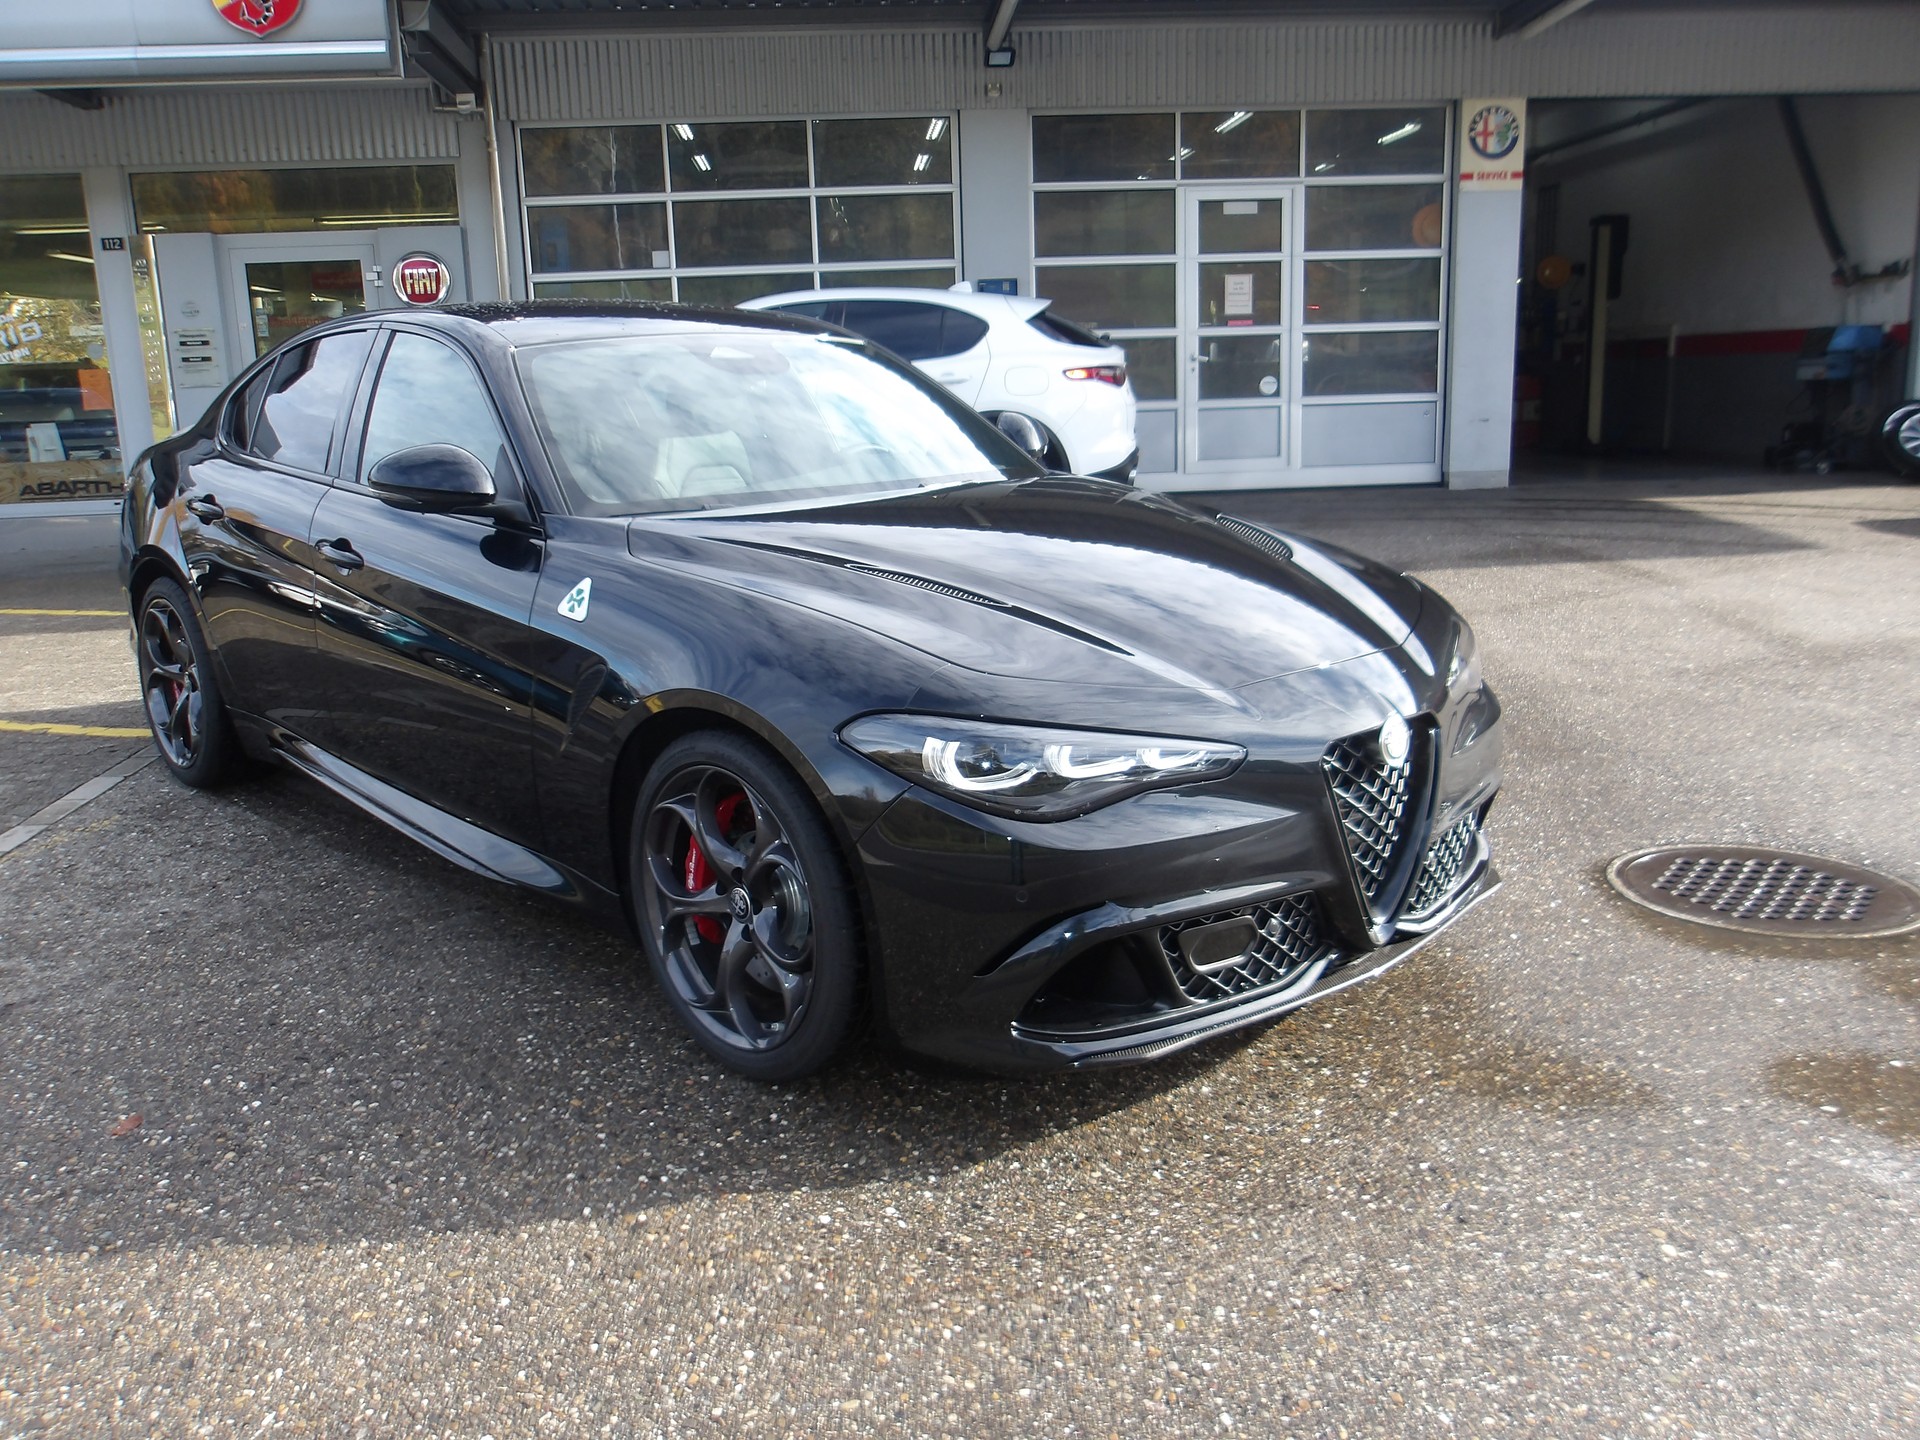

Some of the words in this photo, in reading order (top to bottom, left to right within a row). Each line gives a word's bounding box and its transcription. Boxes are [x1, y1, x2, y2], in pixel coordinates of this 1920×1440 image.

[1476, 170, 1508, 181] SERVICE
[104, 239, 121, 249] 112
[405, 268, 438, 294] FIAT
[20, 480, 125, 496] ABARTH
